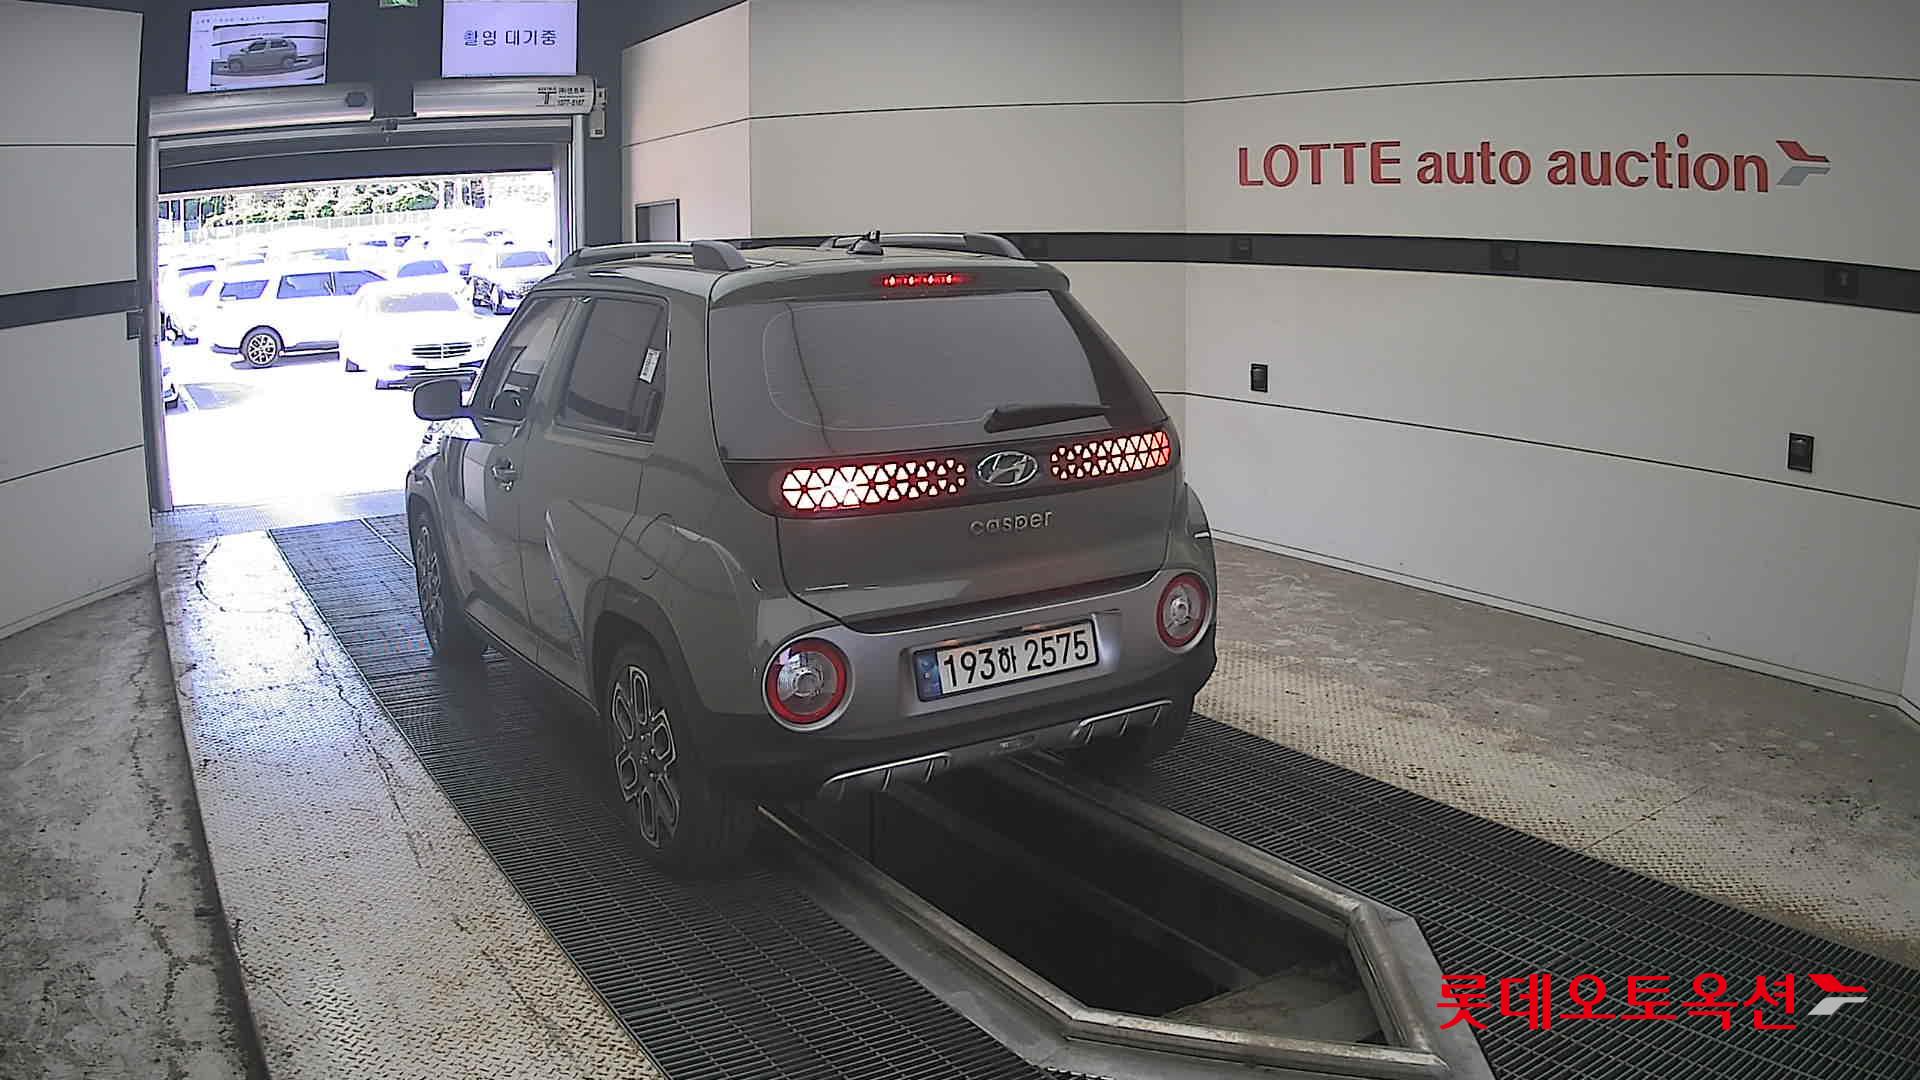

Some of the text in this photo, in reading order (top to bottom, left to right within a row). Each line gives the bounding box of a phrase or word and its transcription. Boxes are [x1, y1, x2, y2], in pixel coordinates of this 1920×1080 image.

[505, 29, 557, 46] 대기중
[1239, 134, 1769, 193] LOTTE auto auction
[970, 511, 1053, 535] casper
[944, 630, 1089, 687] 193하 2575
